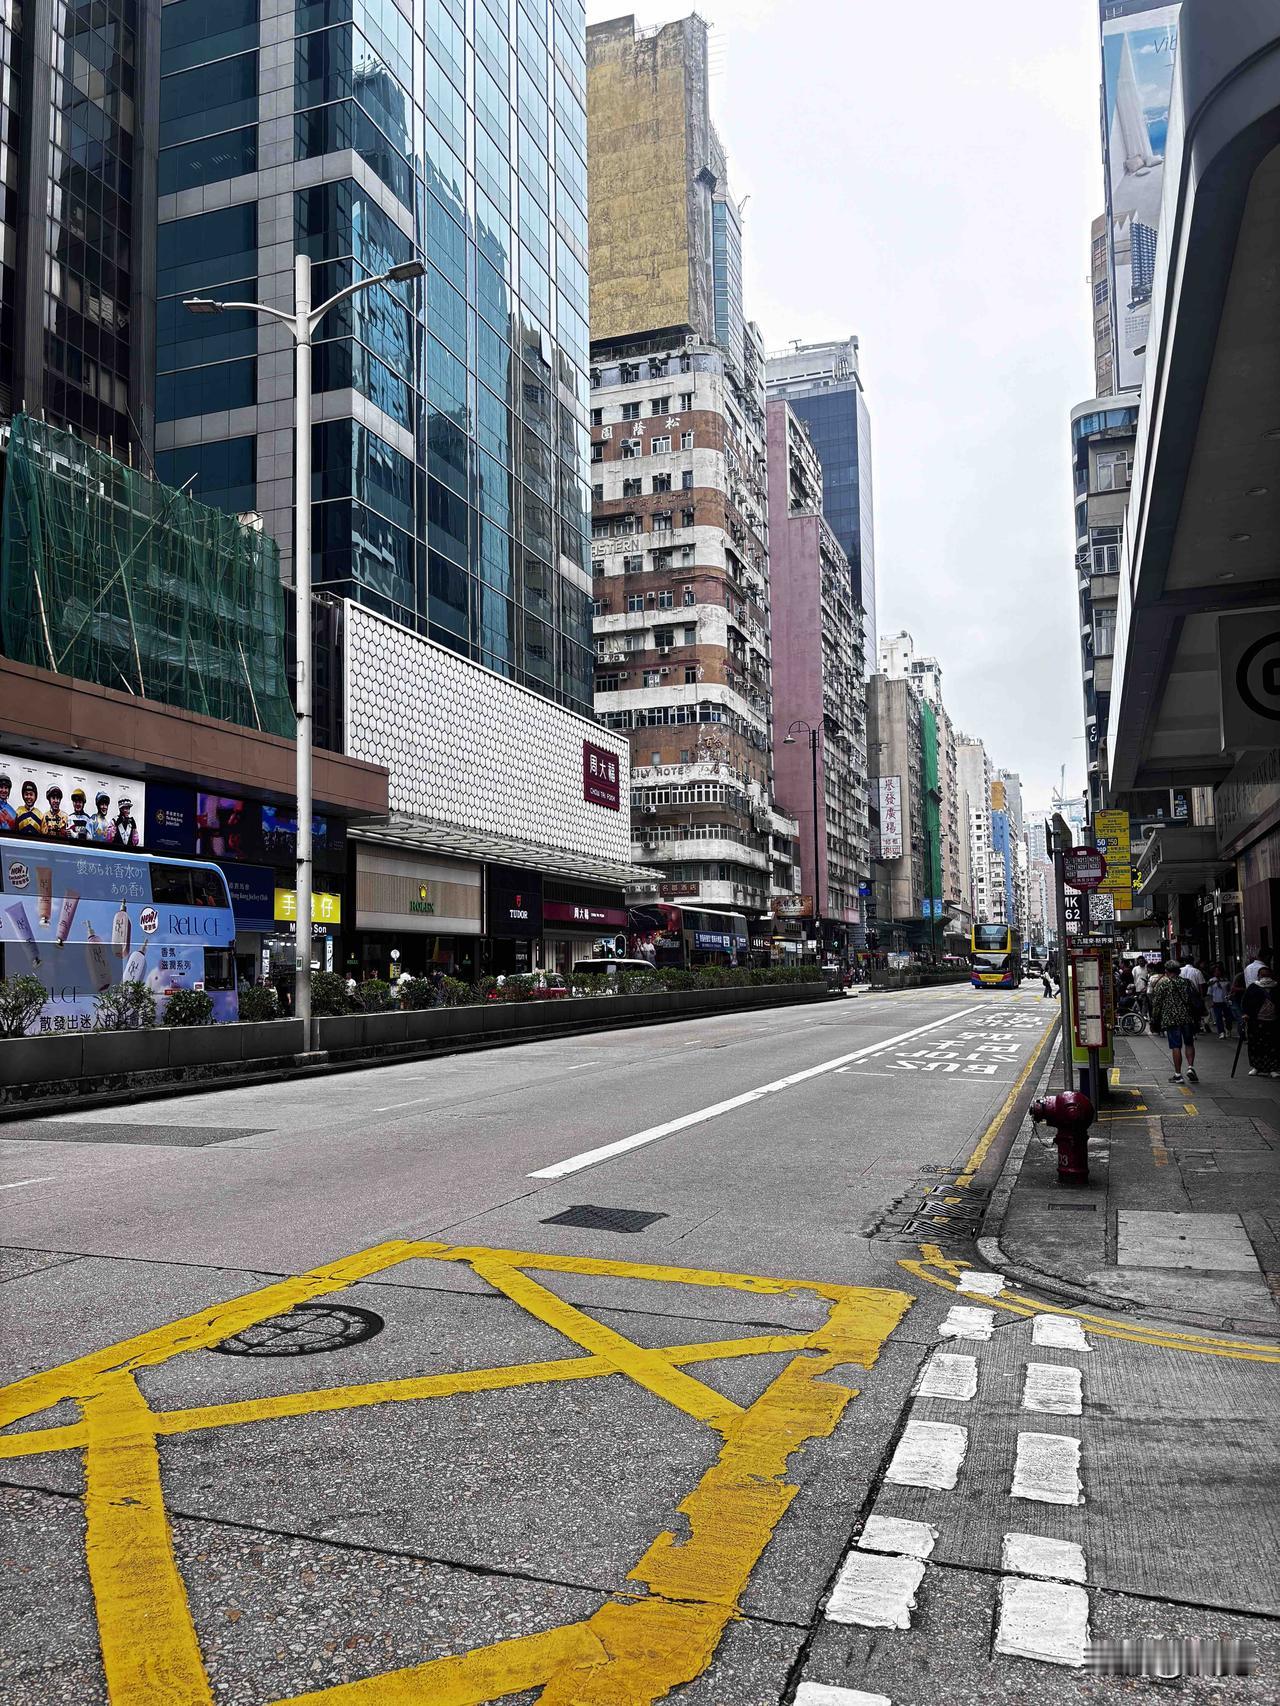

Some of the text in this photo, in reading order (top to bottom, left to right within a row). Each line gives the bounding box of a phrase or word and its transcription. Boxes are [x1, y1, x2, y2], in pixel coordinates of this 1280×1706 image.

[589, 753, 616, 782] 周大福
[589, 787, 600, 796] CHOW
[281, 894, 333, 918] 手仔
[410, 900, 434, 913] ROLEX
[509, 909, 529, 919] TUDOR
[1065, 910, 1080, 920] 62
[313, 924, 327, 934] Son
[894, 1049, 1020, 1062] STOP
[886, 1059, 998, 1075] BUS
